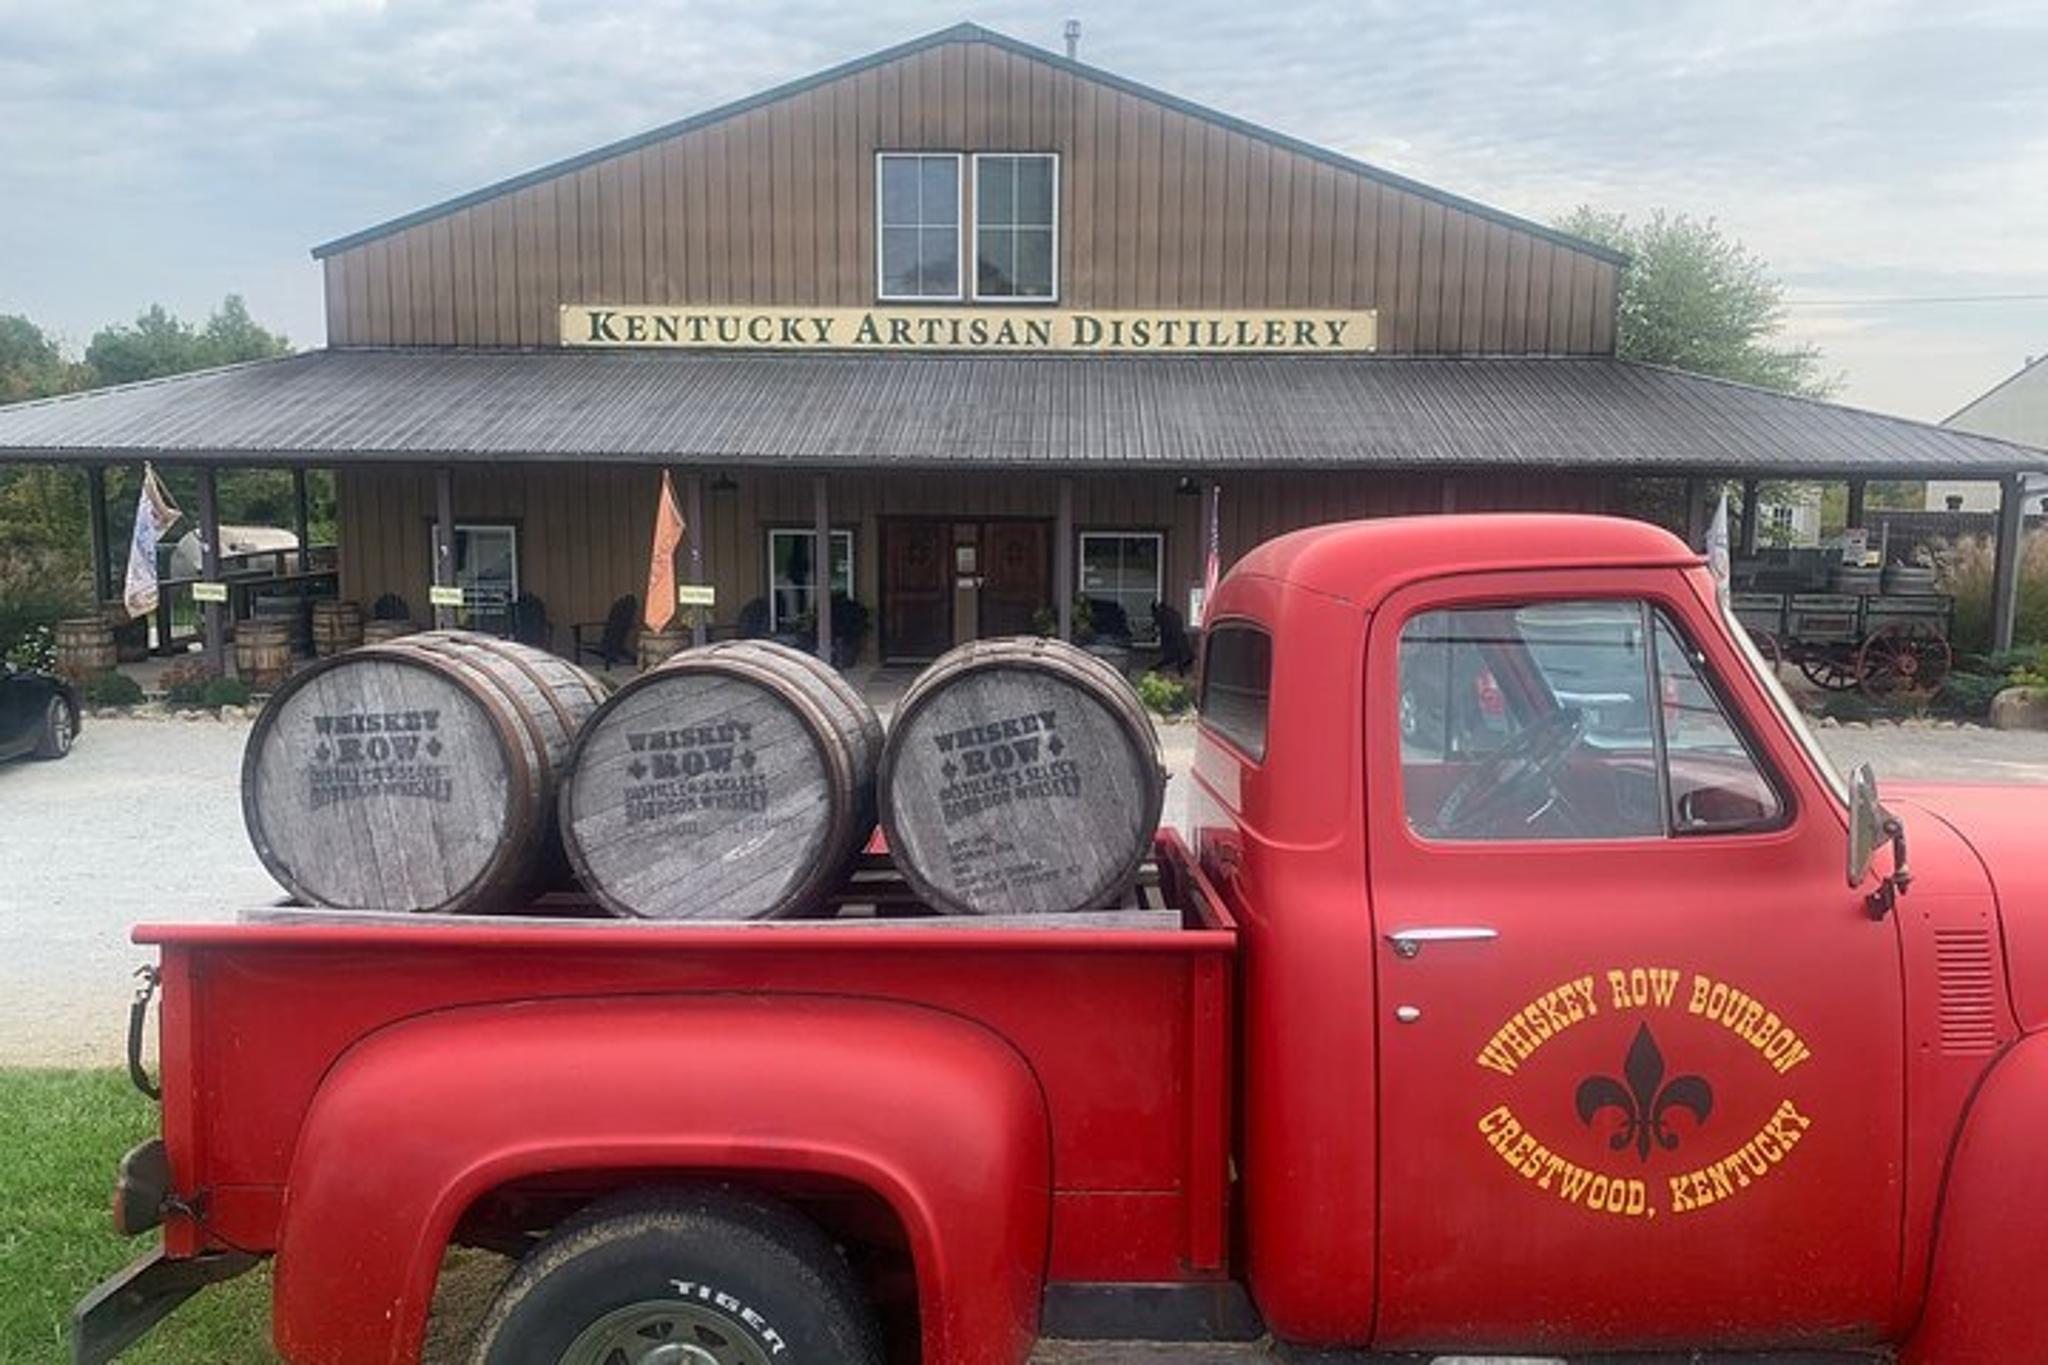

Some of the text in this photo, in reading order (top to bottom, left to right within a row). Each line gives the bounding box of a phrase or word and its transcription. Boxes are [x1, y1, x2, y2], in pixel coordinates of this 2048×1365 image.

[587, 312, 1350, 347] KENTUCKY ARTISAN DISTILLERY
[313, 710, 440, 735] WHISKEY
[627, 722, 752, 751] WHISKEY
[934, 710, 1056, 753] WHISKEY
[337, 736, 421, 763] ROW
[651, 749, 732, 778] ROW
[962, 737, 1040, 777] ROW
[1475, 968, 1811, 1076] WHISKEY ROW BOURBON
[1477, 1100, 1812, 1219] CRESTWOOD, KENTUCKY
[670, 1278, 786, 1354] TIGER
